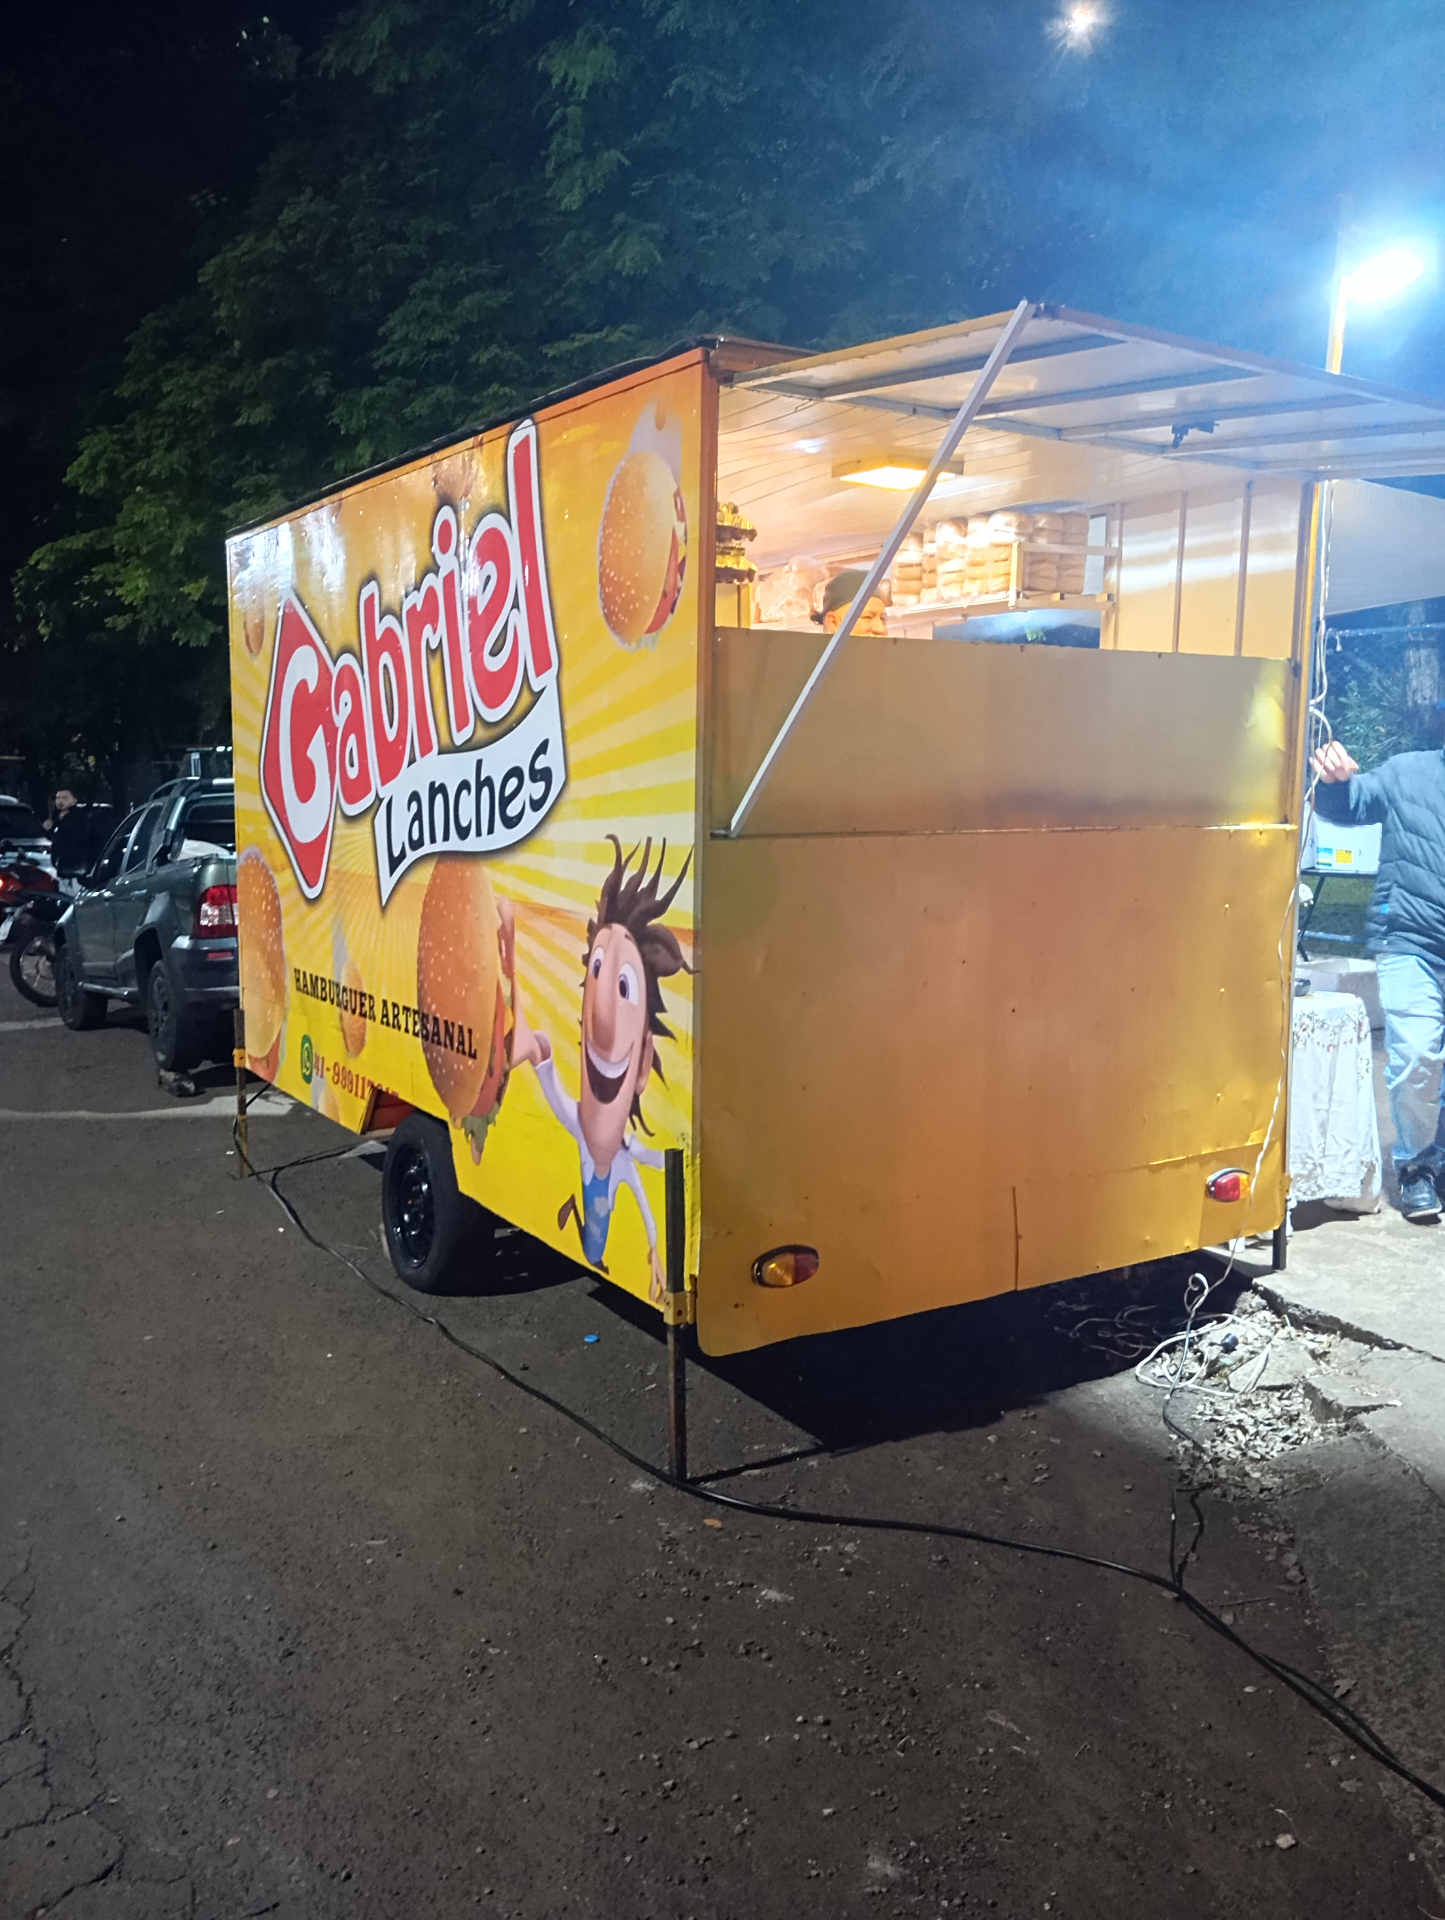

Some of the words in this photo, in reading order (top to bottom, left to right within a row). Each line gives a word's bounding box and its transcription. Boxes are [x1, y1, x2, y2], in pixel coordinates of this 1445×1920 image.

[276, 419, 557, 844] Gabriel
[384, 737, 554, 879] Lanches
[294, 967, 376, 1022] HAMBURGUER
[380, 998, 477, 1060] ARTESANAL
